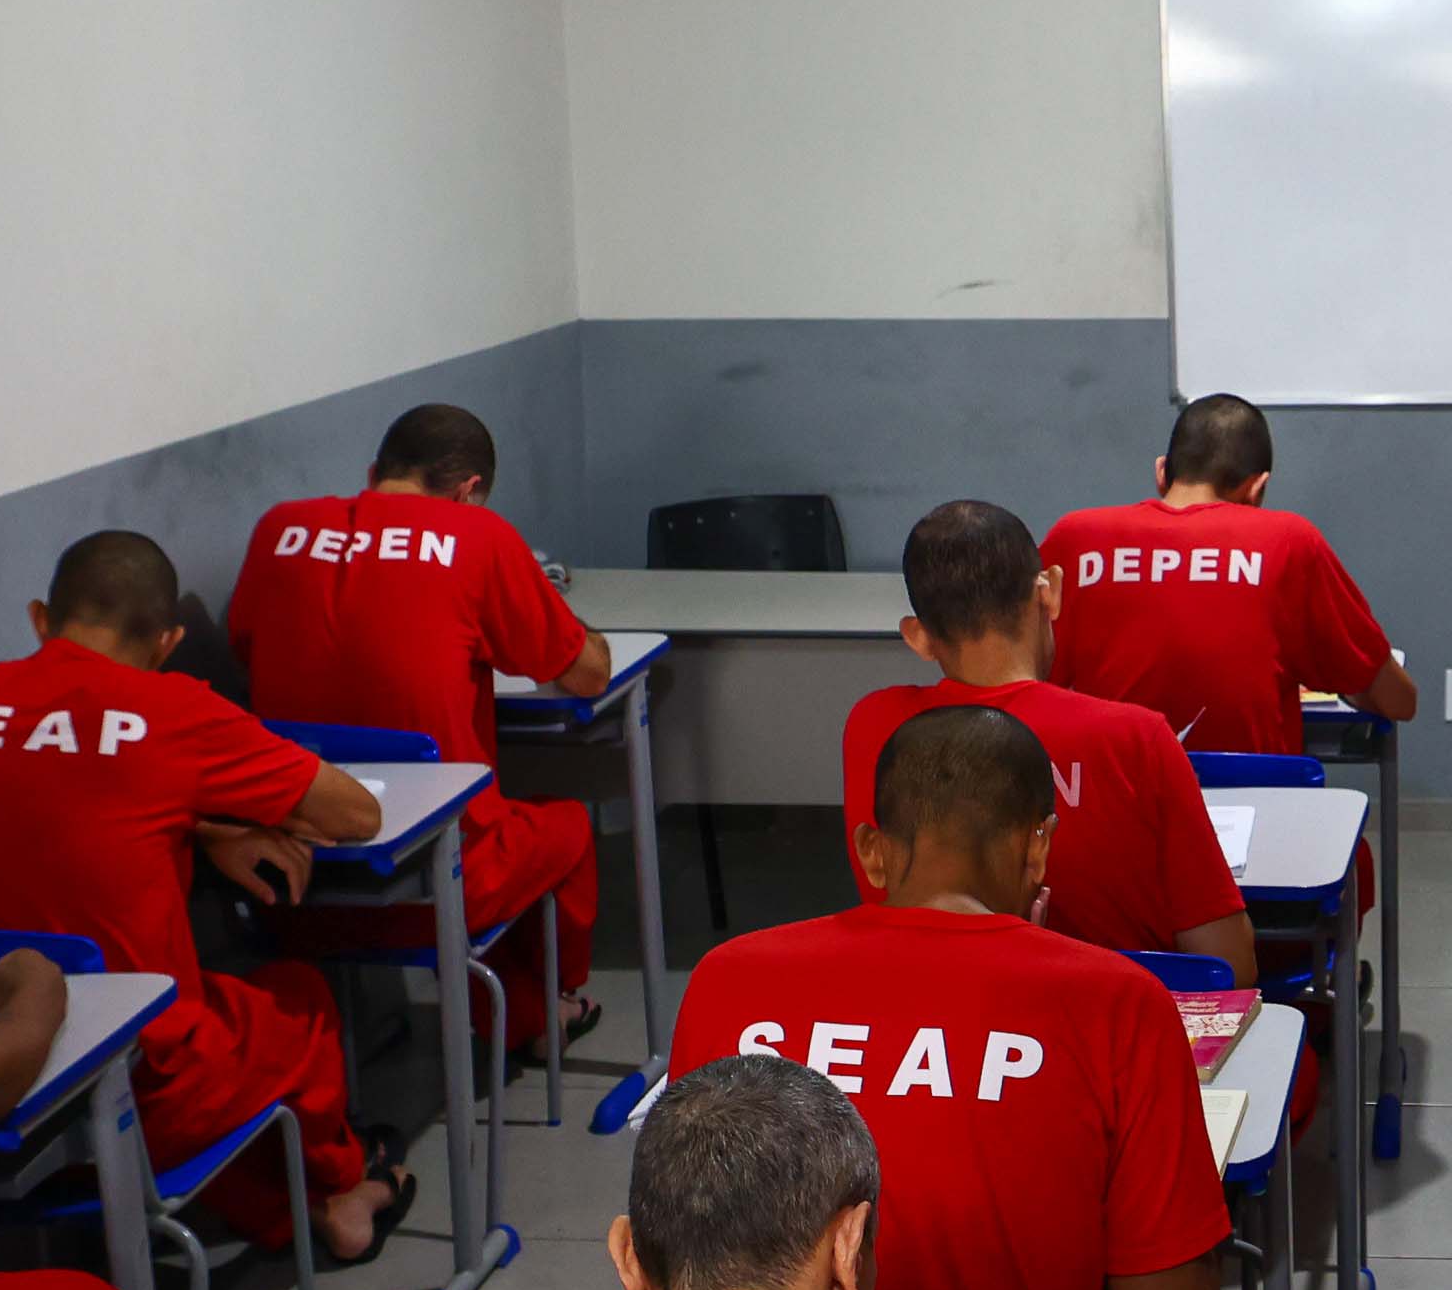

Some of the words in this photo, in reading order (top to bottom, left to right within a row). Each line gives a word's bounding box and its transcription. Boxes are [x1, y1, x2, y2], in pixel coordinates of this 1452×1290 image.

[274, 526, 456, 568] DEPEN
[1078, 547, 1263, 587] DEPEN
[738, 1021, 1045, 1102] SEAP
